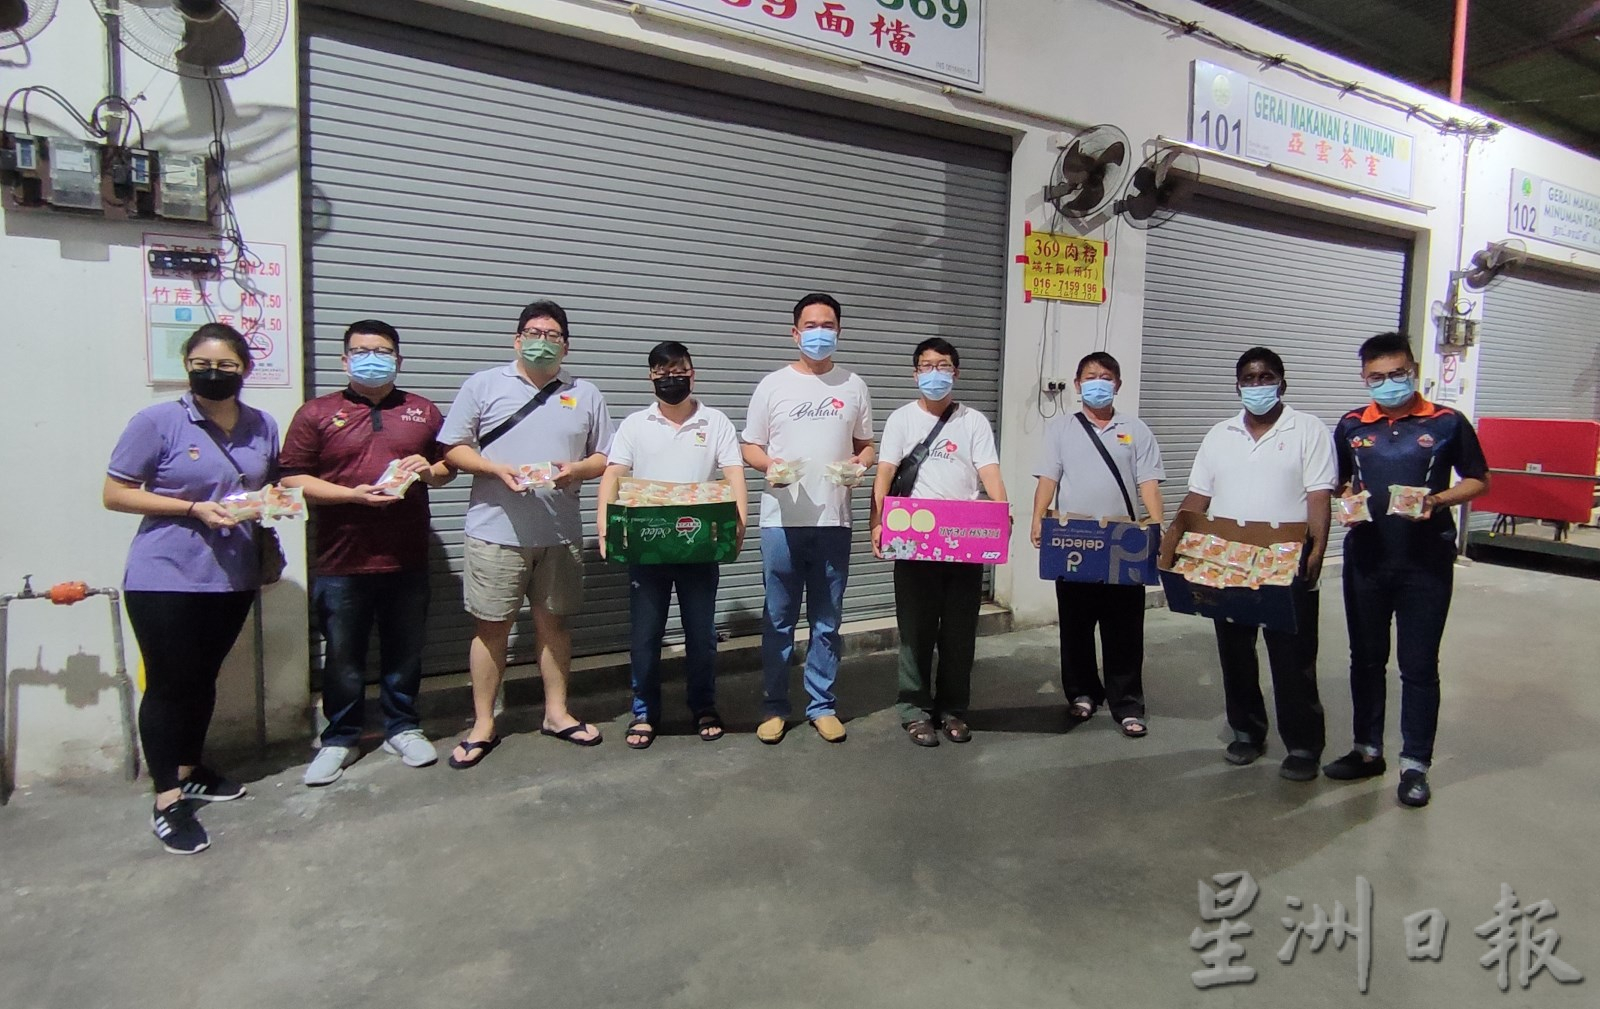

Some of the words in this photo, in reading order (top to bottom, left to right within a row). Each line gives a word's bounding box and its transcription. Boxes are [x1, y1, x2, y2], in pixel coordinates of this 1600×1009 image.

[876, 0, 967, 28] 69
[815, 2, 915, 56] 面檔
[1200, 110, 1241, 155] 101
[1254, 91, 1288, 126] GERAI
[1291, 103, 1341, 142] MAKANAN
[1343, 120, 1349, 144] &
[1352, 123, 1395, 159] MINUMAN
[1287, 132, 1381, 177] 亞雲茶室
[1513, 202, 1537, 233] 102
[1034, 240, 1060, 257] 369
[259, 262, 280, 276] 2.50
[152, 286, 213, 305] 竹蔗水
[789, 396, 839, 421] Bahau
[640, 527, 671, 542] Select
[939, 526, 967, 538] PEAR
[969, 528, 1000, 538] FRESH
[1051, 537, 1104, 551] delecta
